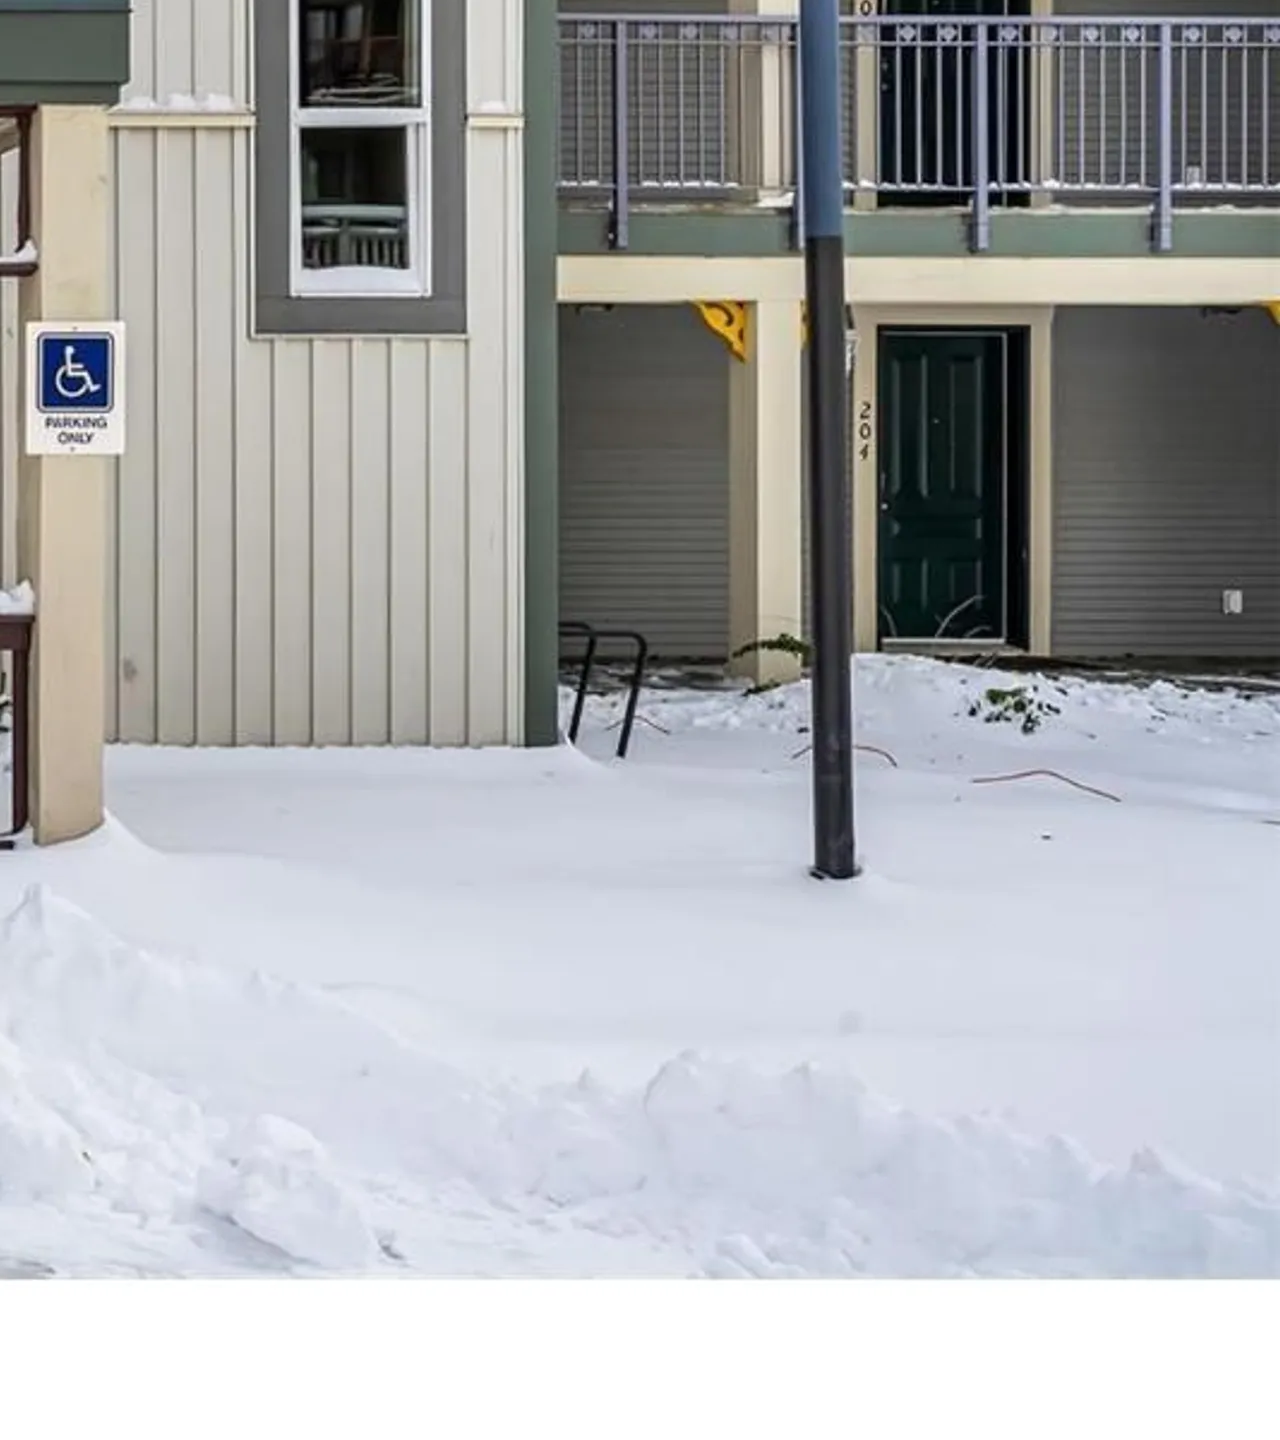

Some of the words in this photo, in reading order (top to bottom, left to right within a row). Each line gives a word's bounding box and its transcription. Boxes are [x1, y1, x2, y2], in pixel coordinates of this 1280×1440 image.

[45, 417, 108, 429] PARKING
[57, 431, 94, 444] ONLY
[859, 401, 871, 461] 204
